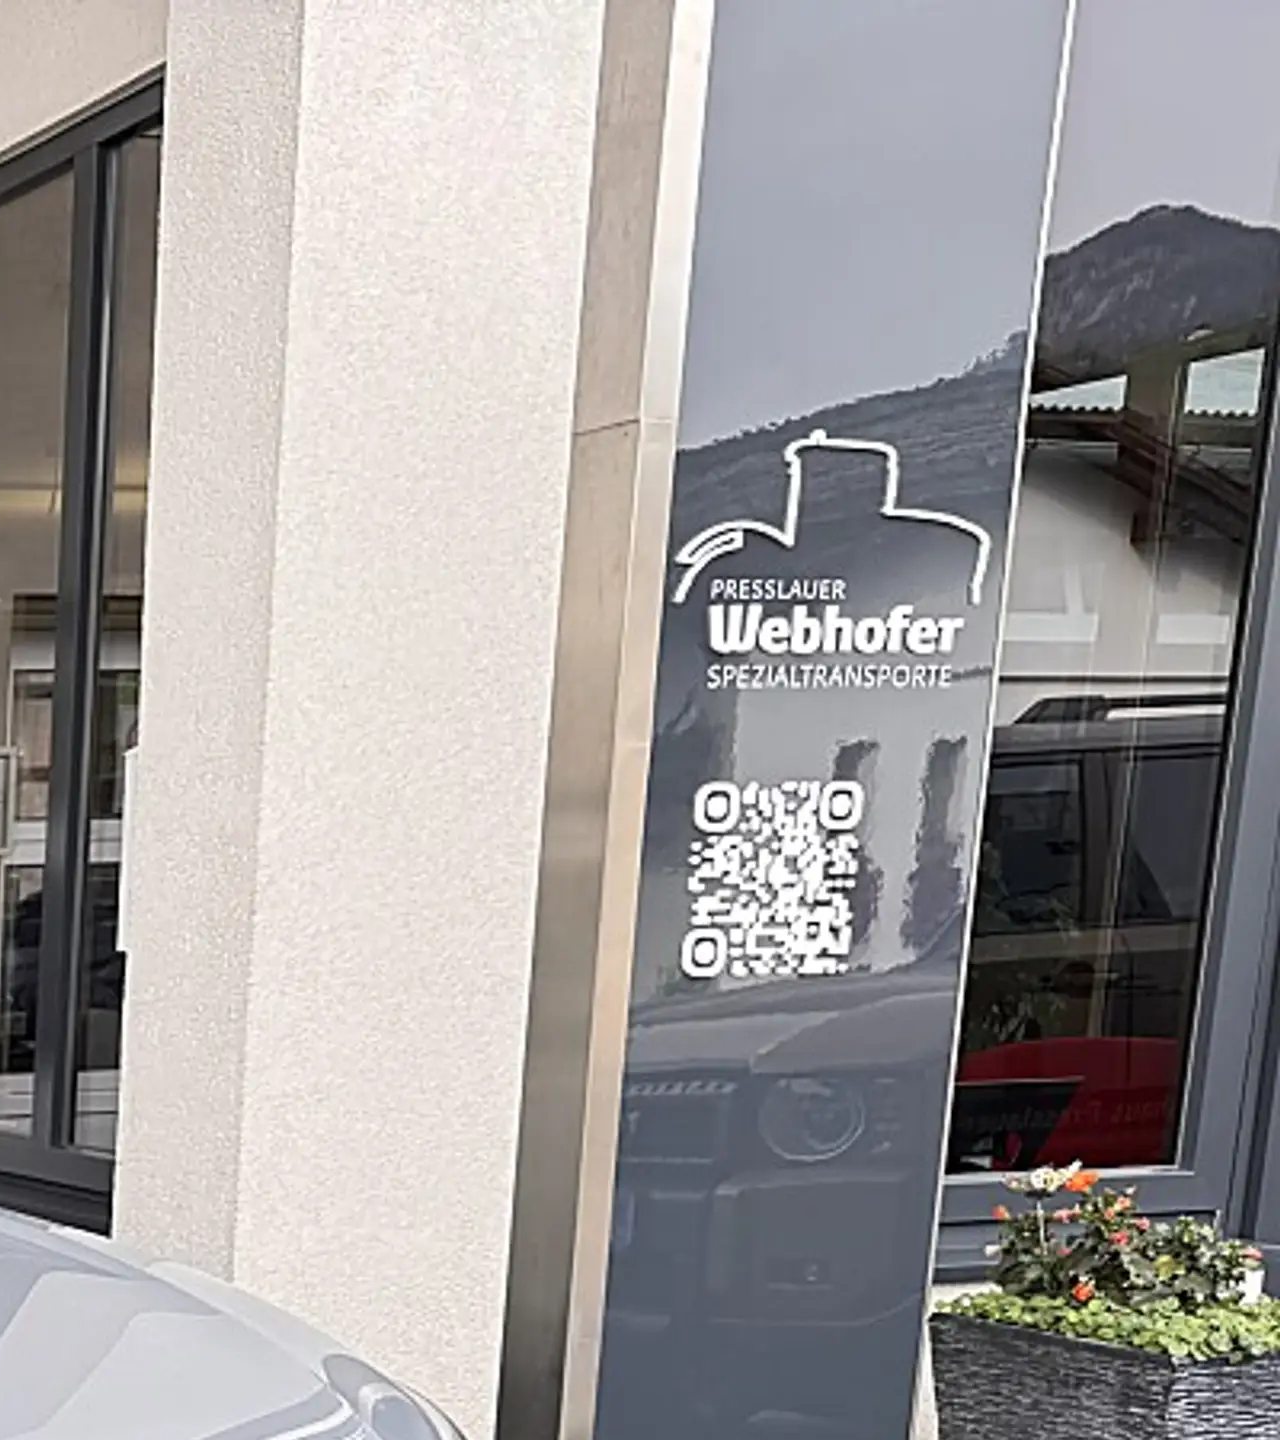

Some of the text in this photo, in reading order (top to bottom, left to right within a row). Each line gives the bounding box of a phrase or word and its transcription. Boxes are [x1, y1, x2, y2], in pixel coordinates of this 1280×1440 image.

[710, 578, 847, 600] PRESSLAUER
[707, 604, 965, 655] Webhofer
[706, 664, 953, 690] SPEZIALTRANSPORTE
